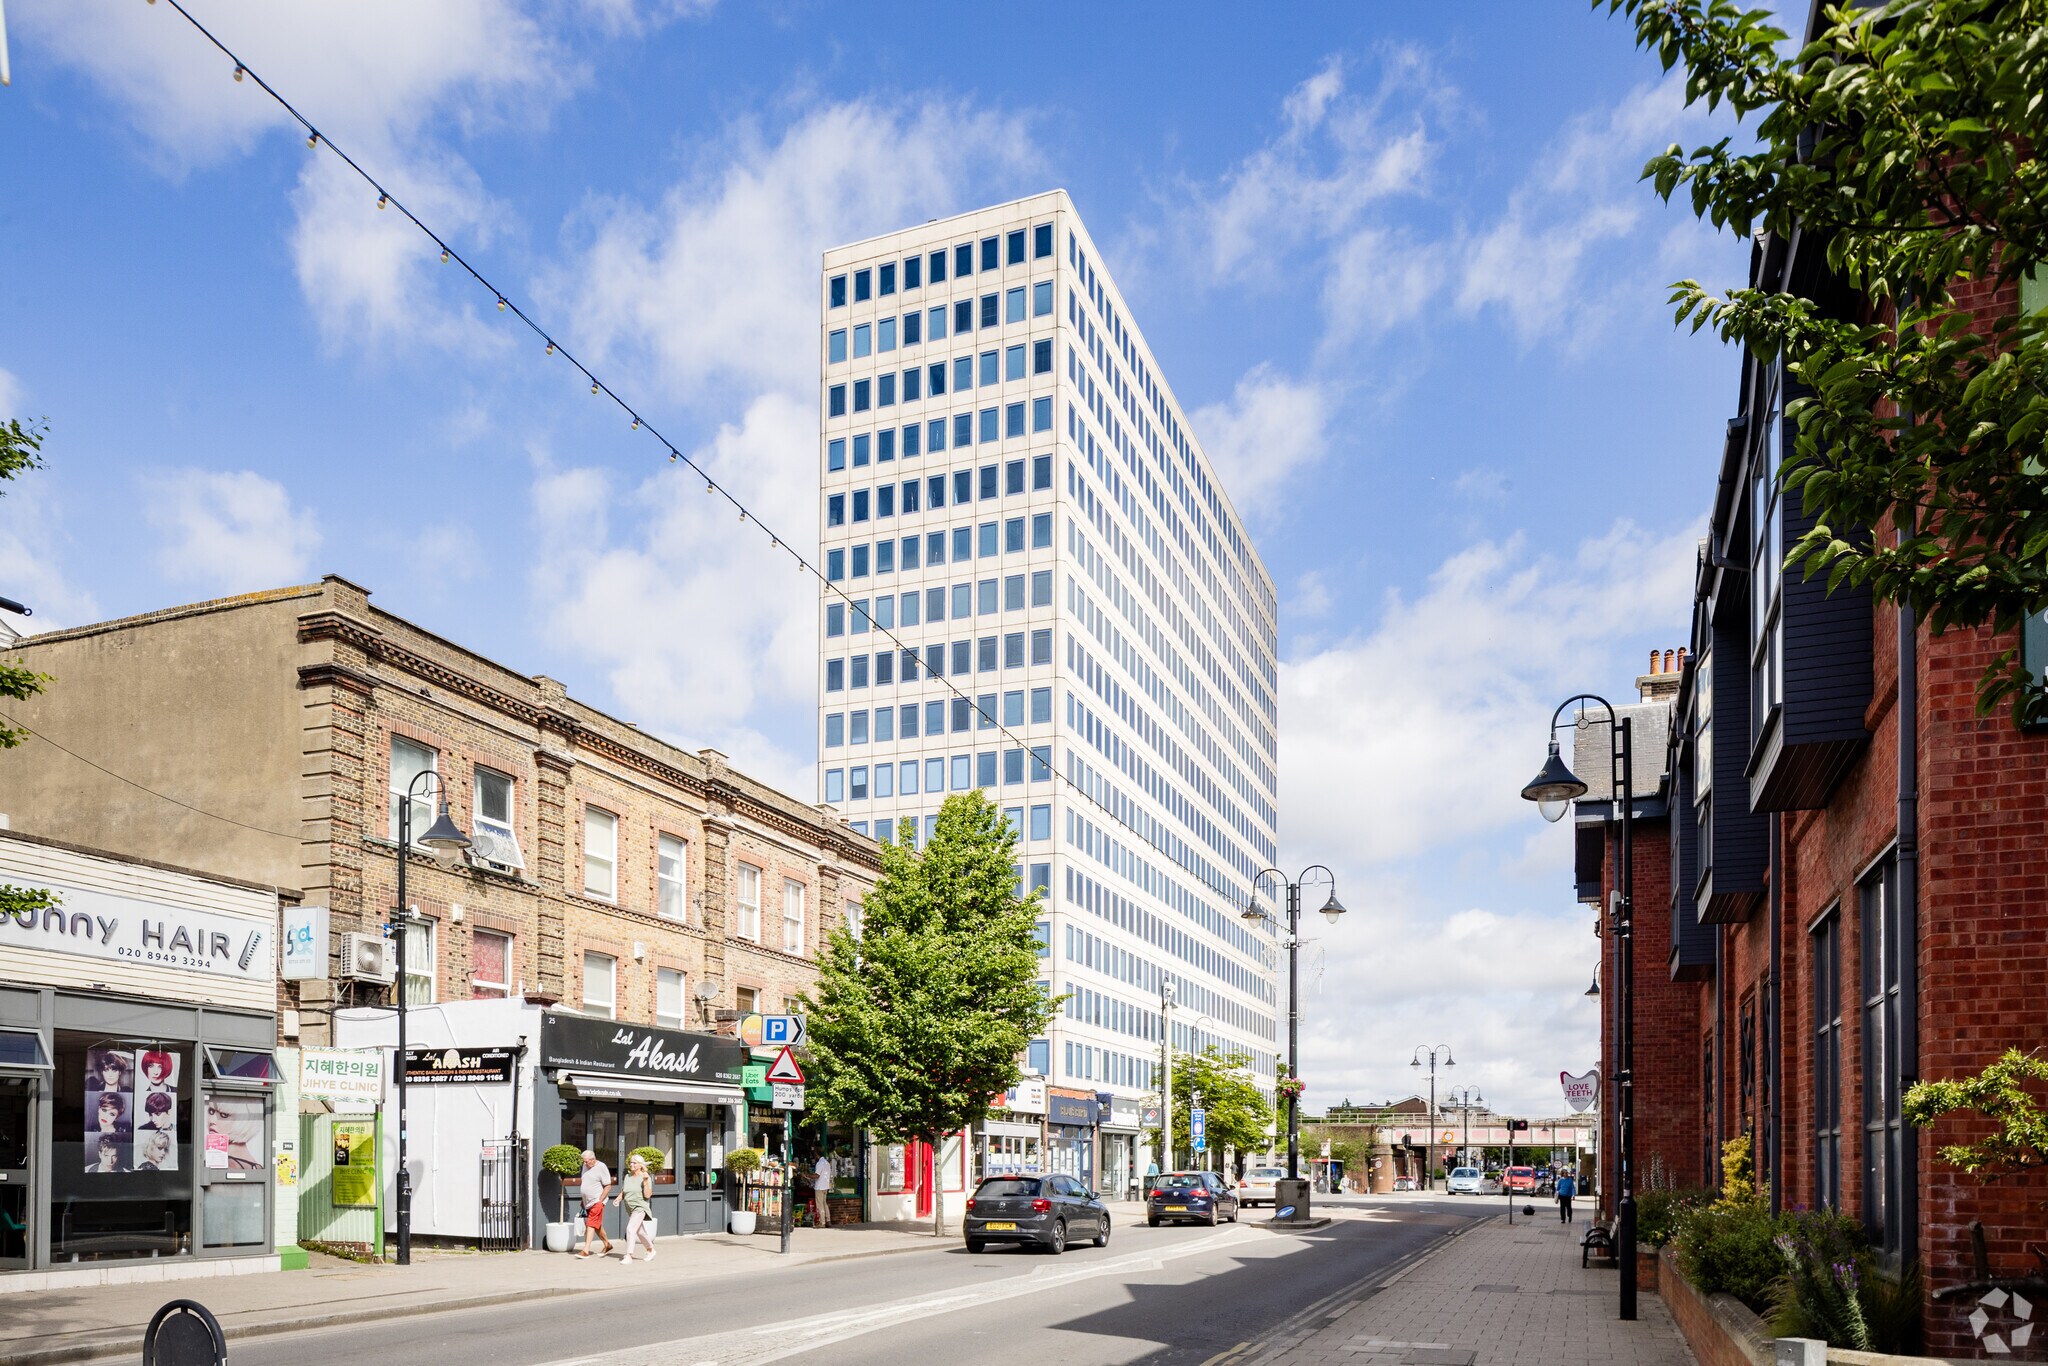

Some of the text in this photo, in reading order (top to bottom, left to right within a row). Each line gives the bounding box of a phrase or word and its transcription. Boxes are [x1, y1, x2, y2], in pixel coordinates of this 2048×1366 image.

[0, 908, 230, 959] unny HAIR
[118, 946, 211, 969] 020 8949 3294
[548, 1017, 556, 1025] 25
[770, 1021, 785, 1039] P
[611, 1028, 634, 1045] Lal
[422, 1052, 481, 1069] Lal AKASH
[624, 1035, 700, 1073] Akash
[305, 1059, 379, 1077] 지혜한의원
[303, 1079, 378, 1092] JIHYE CLINIC
